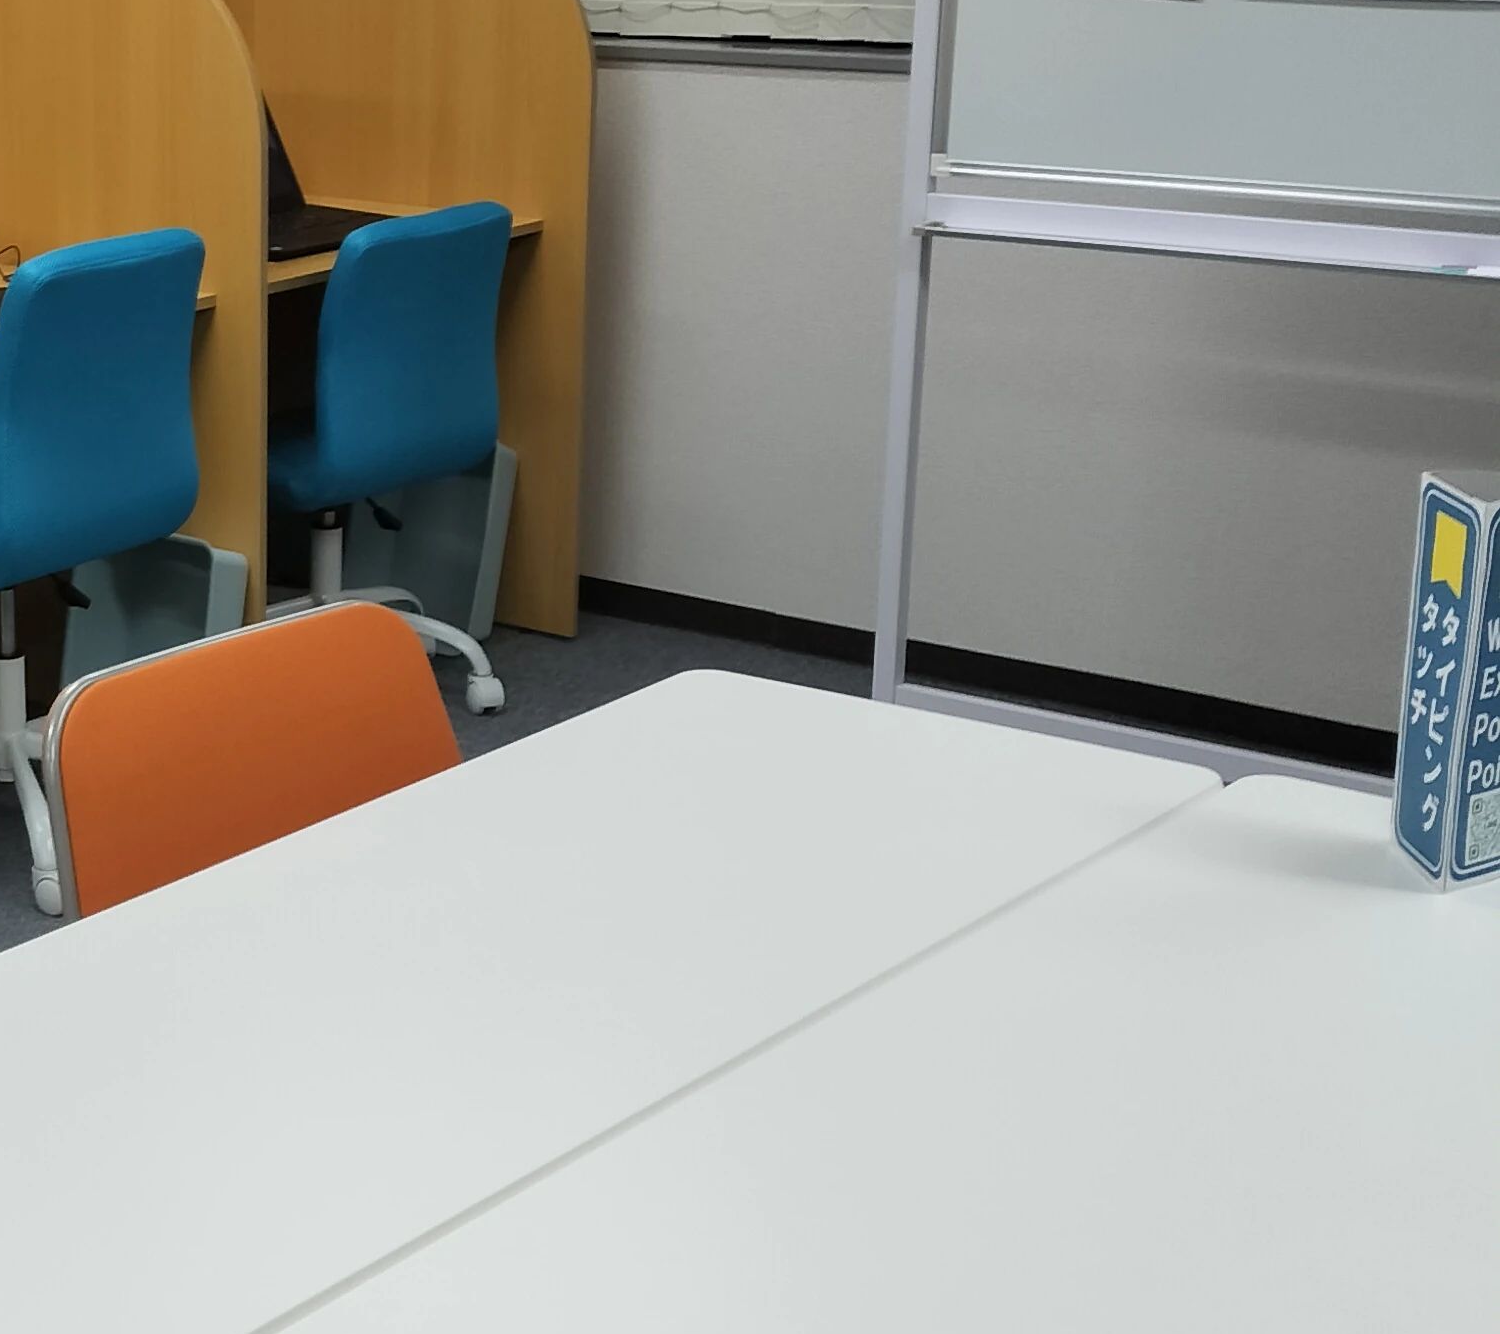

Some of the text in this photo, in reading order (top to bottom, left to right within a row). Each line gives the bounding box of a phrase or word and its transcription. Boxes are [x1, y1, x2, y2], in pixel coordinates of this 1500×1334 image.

[1410, 592, 1439, 725] タッチ
[1421, 606, 1461, 833] タイピング
